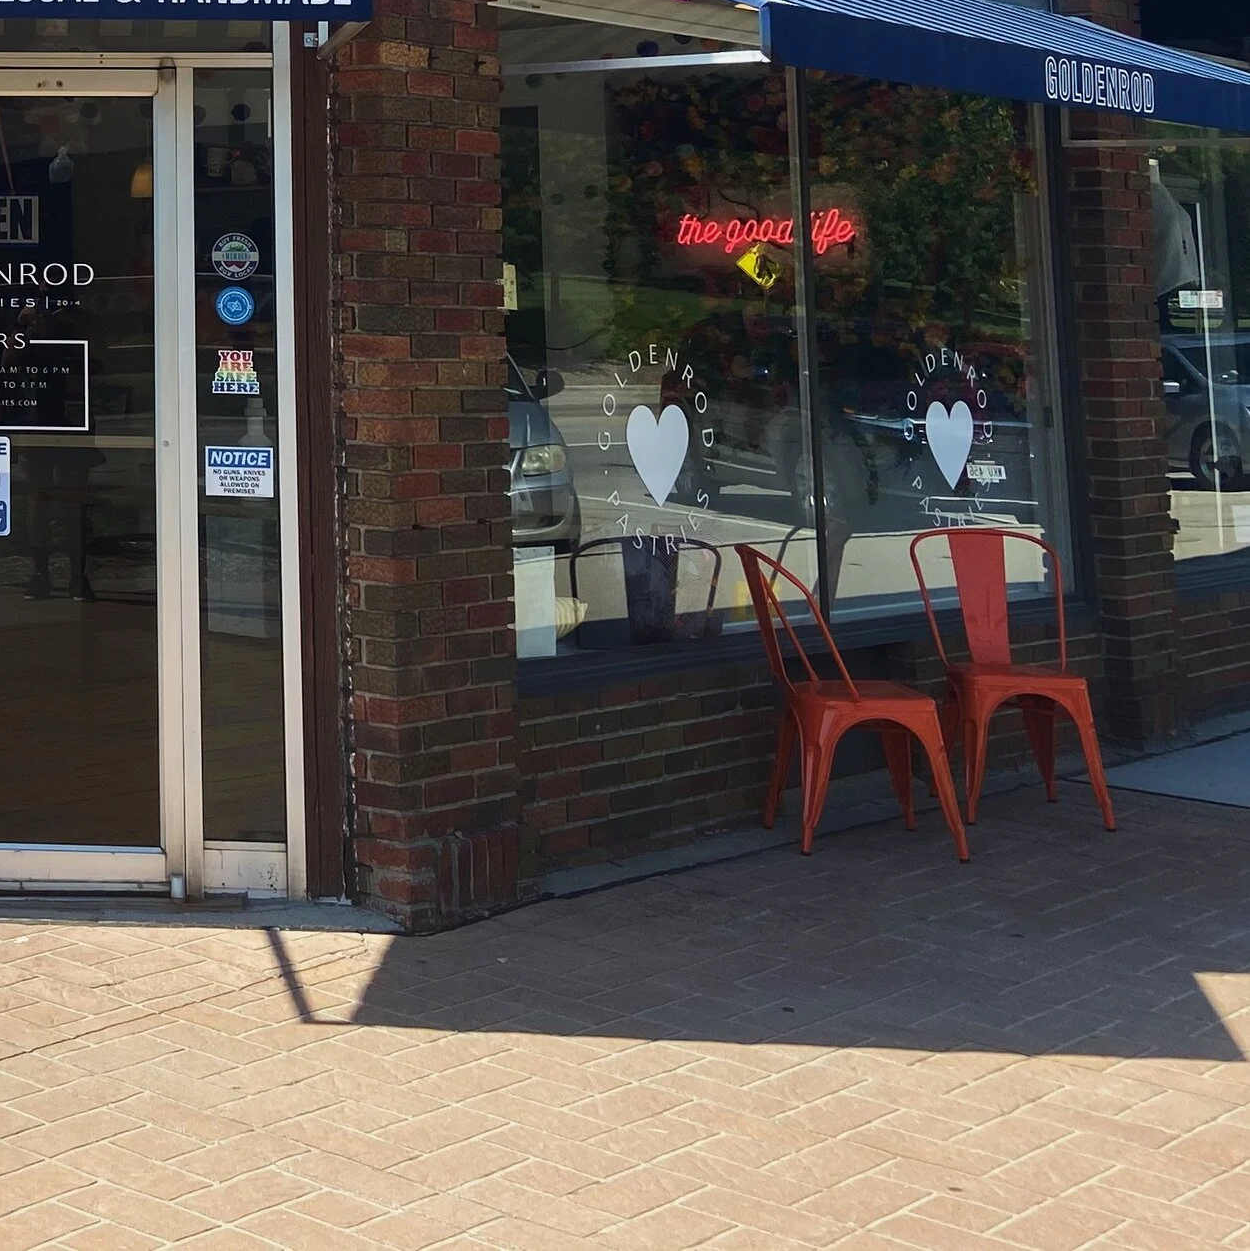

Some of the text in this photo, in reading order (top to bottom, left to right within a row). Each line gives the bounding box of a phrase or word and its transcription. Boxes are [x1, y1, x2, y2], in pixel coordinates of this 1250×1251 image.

[1045, 56, 1154, 113] GOLDENROD
[678, 208, 856, 254] the good ife
[217, 235, 253, 248] BUY FRESH
[234, 266, 254, 278] LOCAL
[220, 351, 252, 362] YOU
[219, 362, 253, 371] ARE
[216, 372, 256, 382] SAFE
[3, 381, 16, 389] TO
[213, 383, 259, 393] HERE
[598, 344, 714, 450] GOLDENROD
[904, 348, 993, 440] GOLDENROD
[210, 451, 268, 466] NOTICE
[607, 489, 709, 556] PASTRIES
